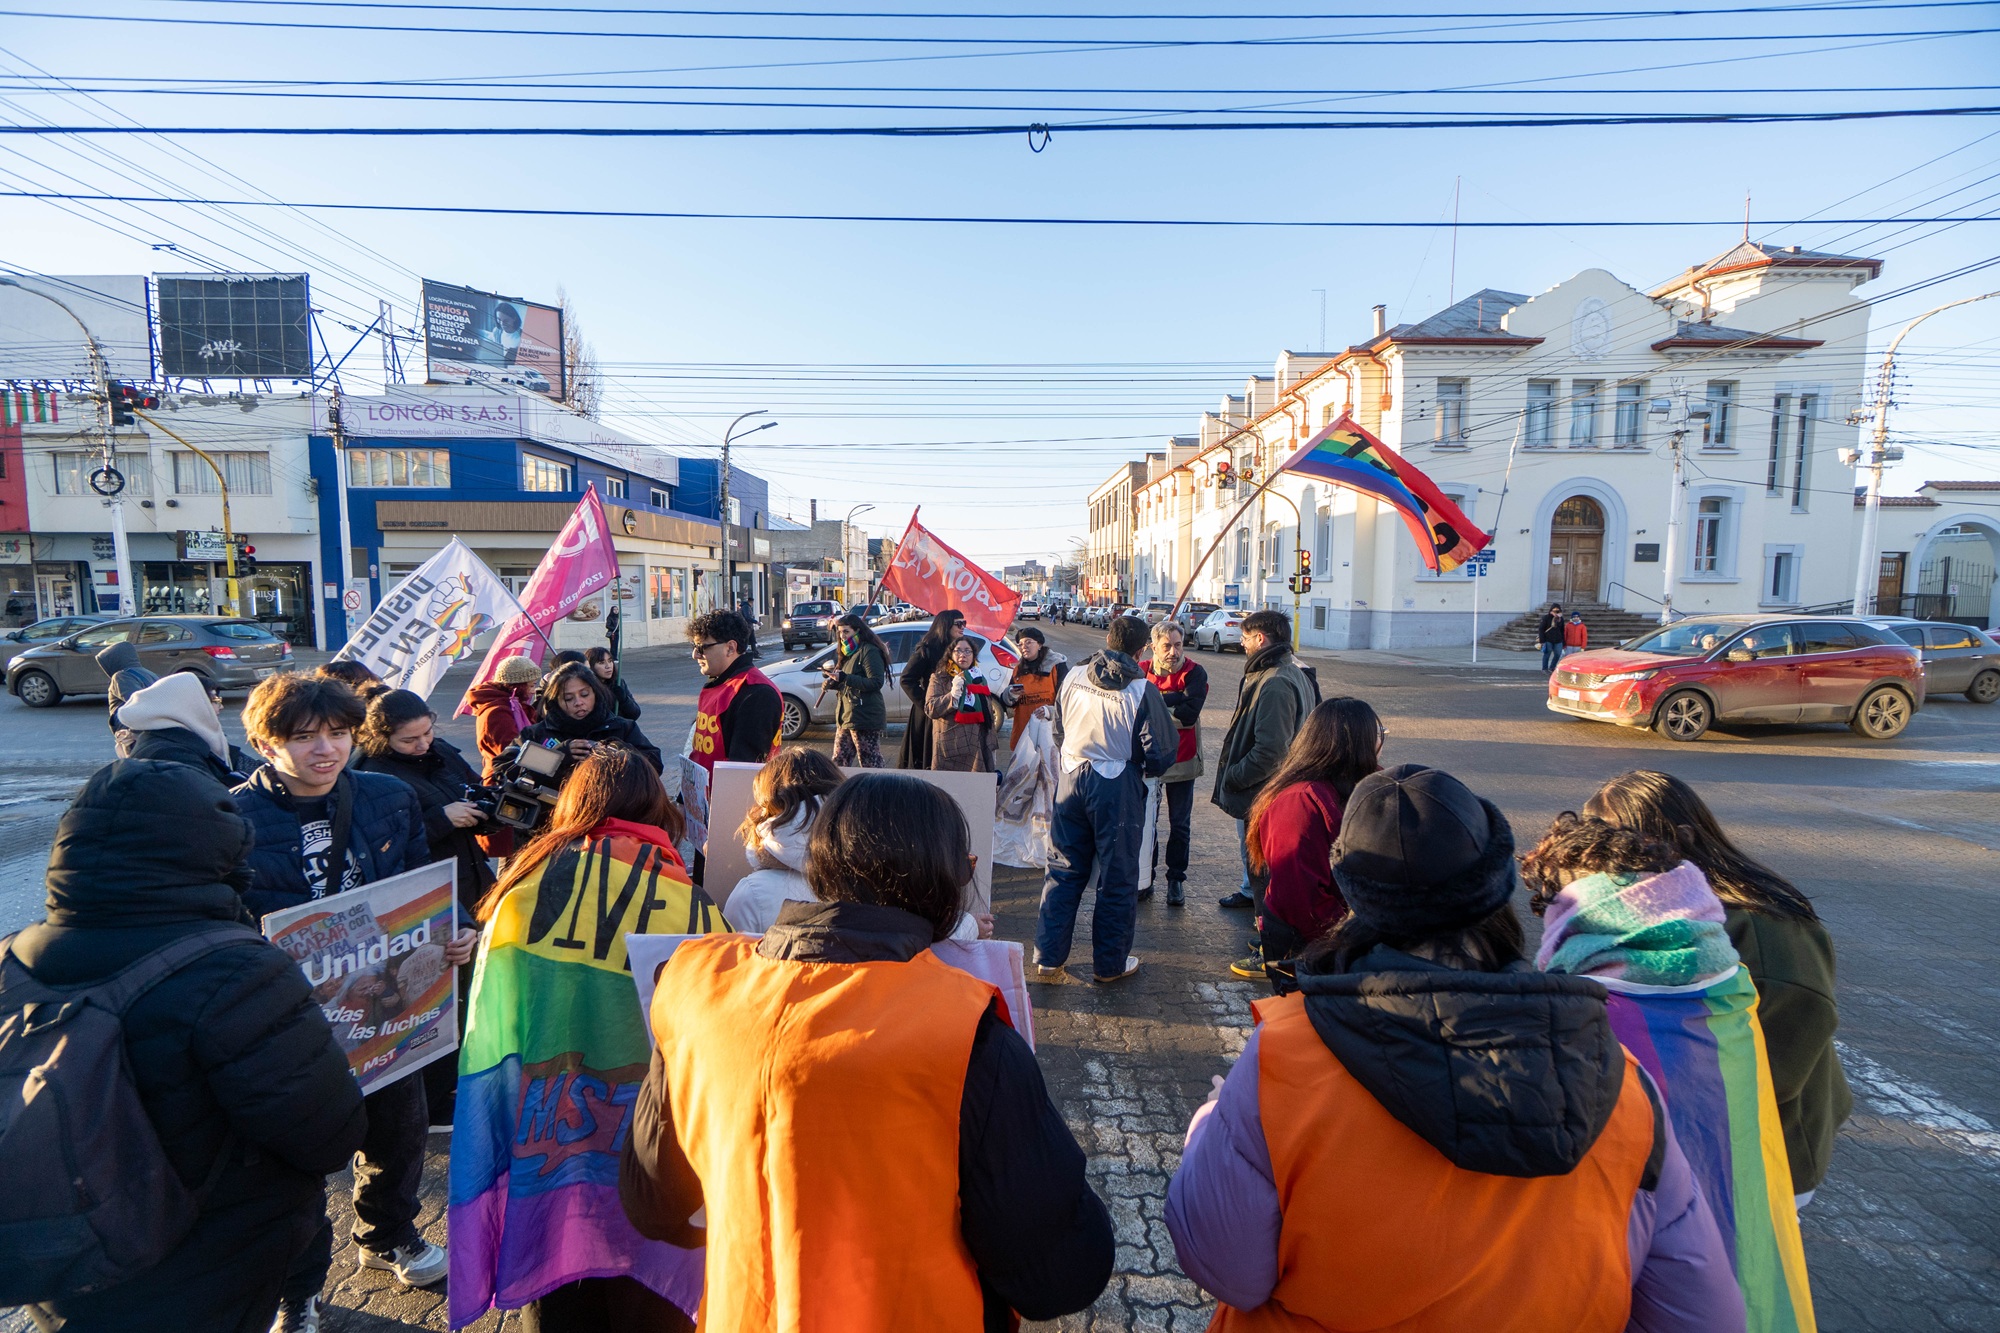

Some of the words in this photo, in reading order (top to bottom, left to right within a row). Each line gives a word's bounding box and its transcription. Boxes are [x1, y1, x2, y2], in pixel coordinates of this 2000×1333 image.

[429, 303, 462, 316] ENVÍOS
[429, 310, 471, 324] CÓRDOBA
[430, 318, 465, 330] BUENOS
[430, 325, 457, 335] AIRES
[430, 332, 480, 346] PATAGONIA
[528, 349, 551, 357] BUENAS
[369, 401, 454, 422] LONCÓN
[461, 405, 514, 421] S.A.S.
[349, 914, 371, 930] con
[301, 918, 430, 987] Unidad
[319, 1004, 364, 1022] odas
[346, 1023, 377, 1039] las
[380, 1007, 441, 1036] luchas
[363, 1047, 397, 1072] MST
